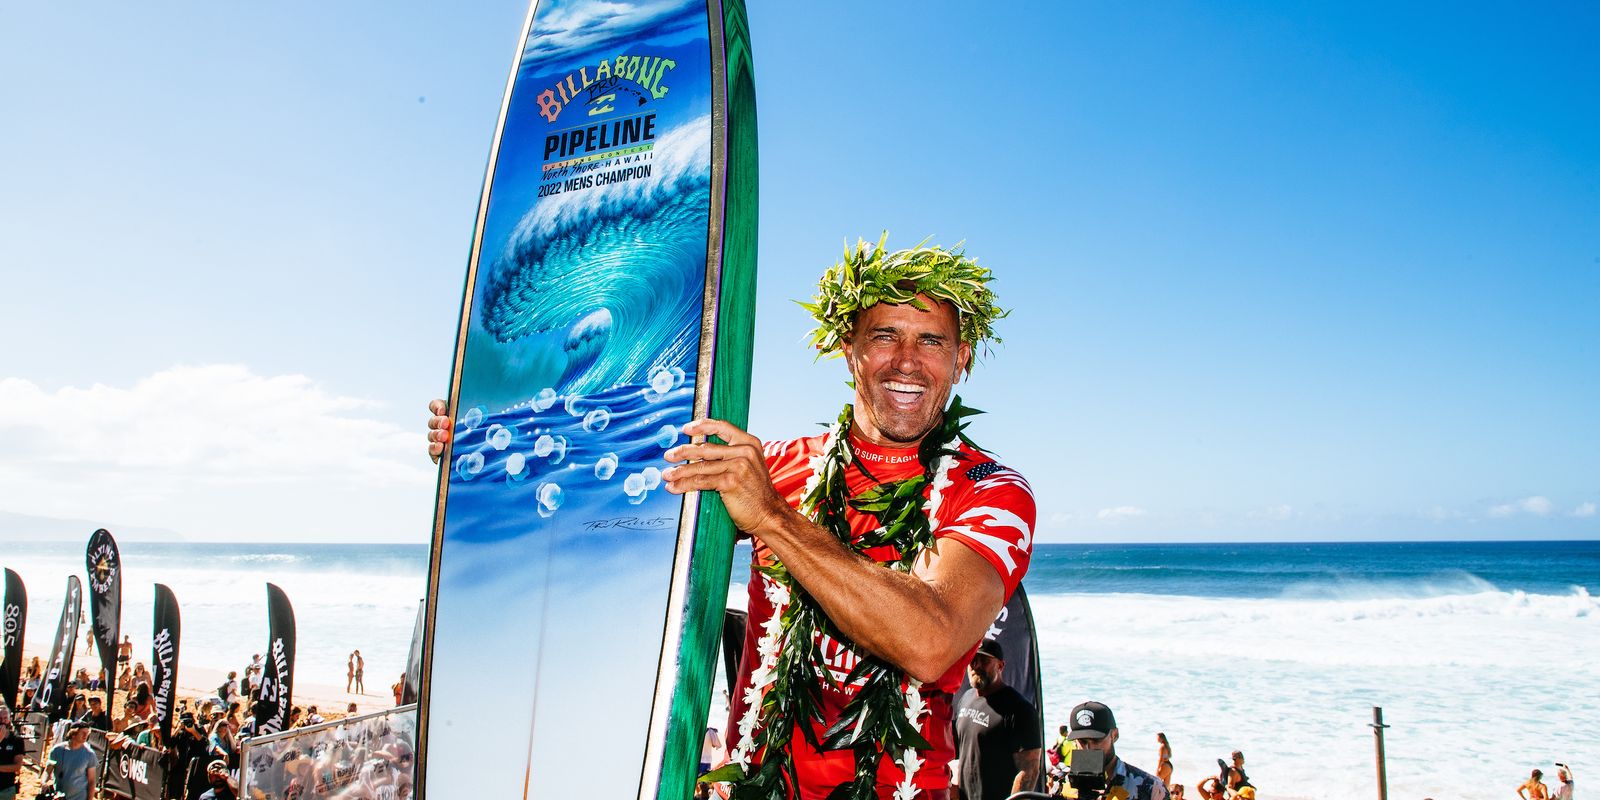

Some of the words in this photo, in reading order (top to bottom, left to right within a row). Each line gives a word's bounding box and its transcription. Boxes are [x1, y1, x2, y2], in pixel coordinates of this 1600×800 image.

[536, 55, 676, 123] BILLABONG
[584, 75, 619, 99] PRO
[544, 114, 657, 161] PIPELINE
[600, 145, 652, 159] CONTEST
[605, 152, 653, 167] HAWAII
[538, 181, 562, 198] 2022
[564, 173, 593, 193] MENS
[596, 164, 652, 187] CHAMPION
[860, 450, 883, 463] SURF
[129, 757, 149, 785] WSL
